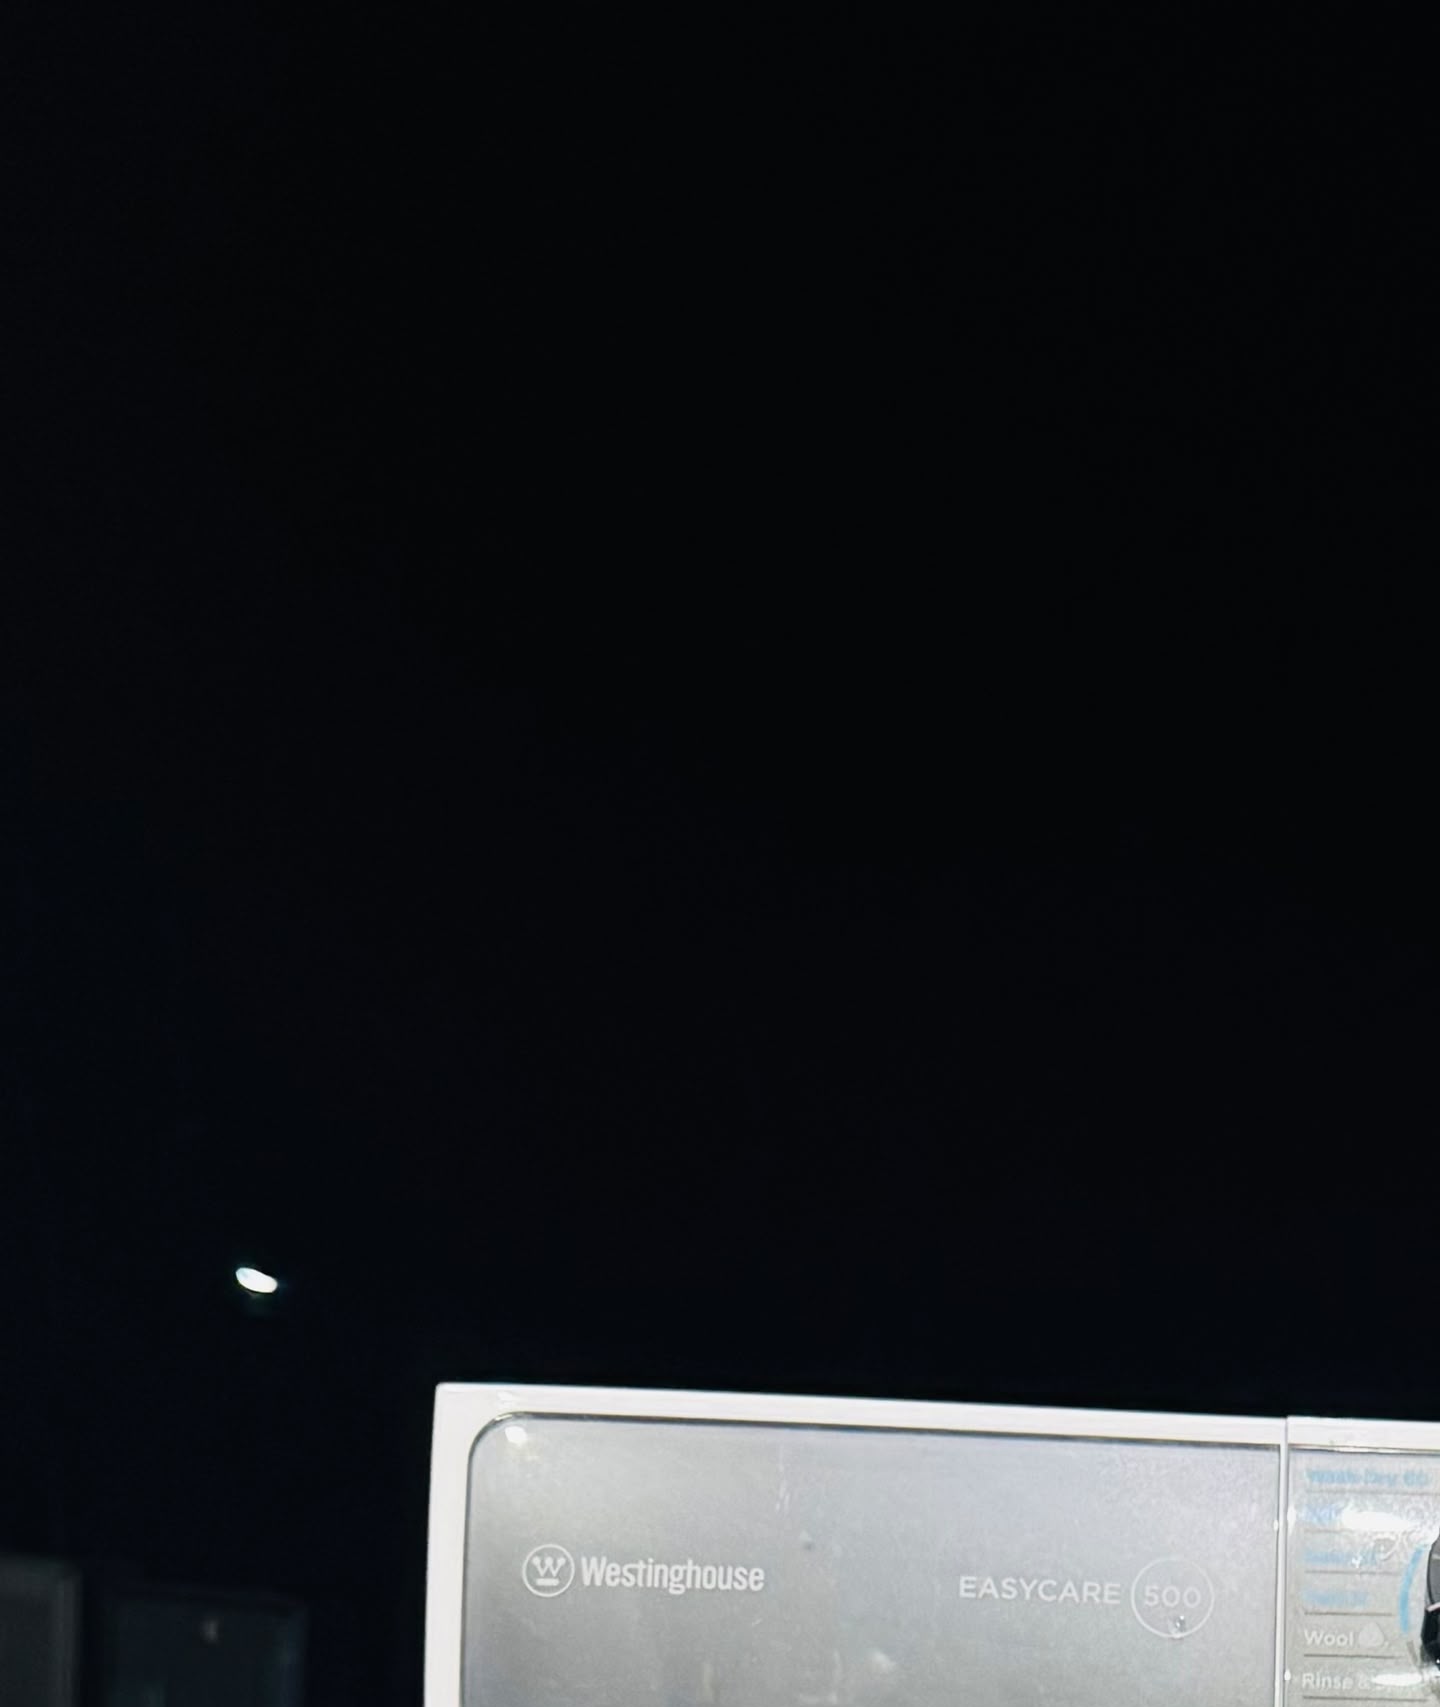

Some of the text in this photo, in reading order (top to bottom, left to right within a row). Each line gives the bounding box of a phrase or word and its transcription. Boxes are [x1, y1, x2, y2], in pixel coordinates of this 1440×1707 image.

[580, 1555, 766, 1595] Westinghouse
[958, 1575, 1202, 1609] EASYCARE 500
[1303, 1629, 1354, 1646] Wool
[1302, 1672, 1353, 1690] Rinse
